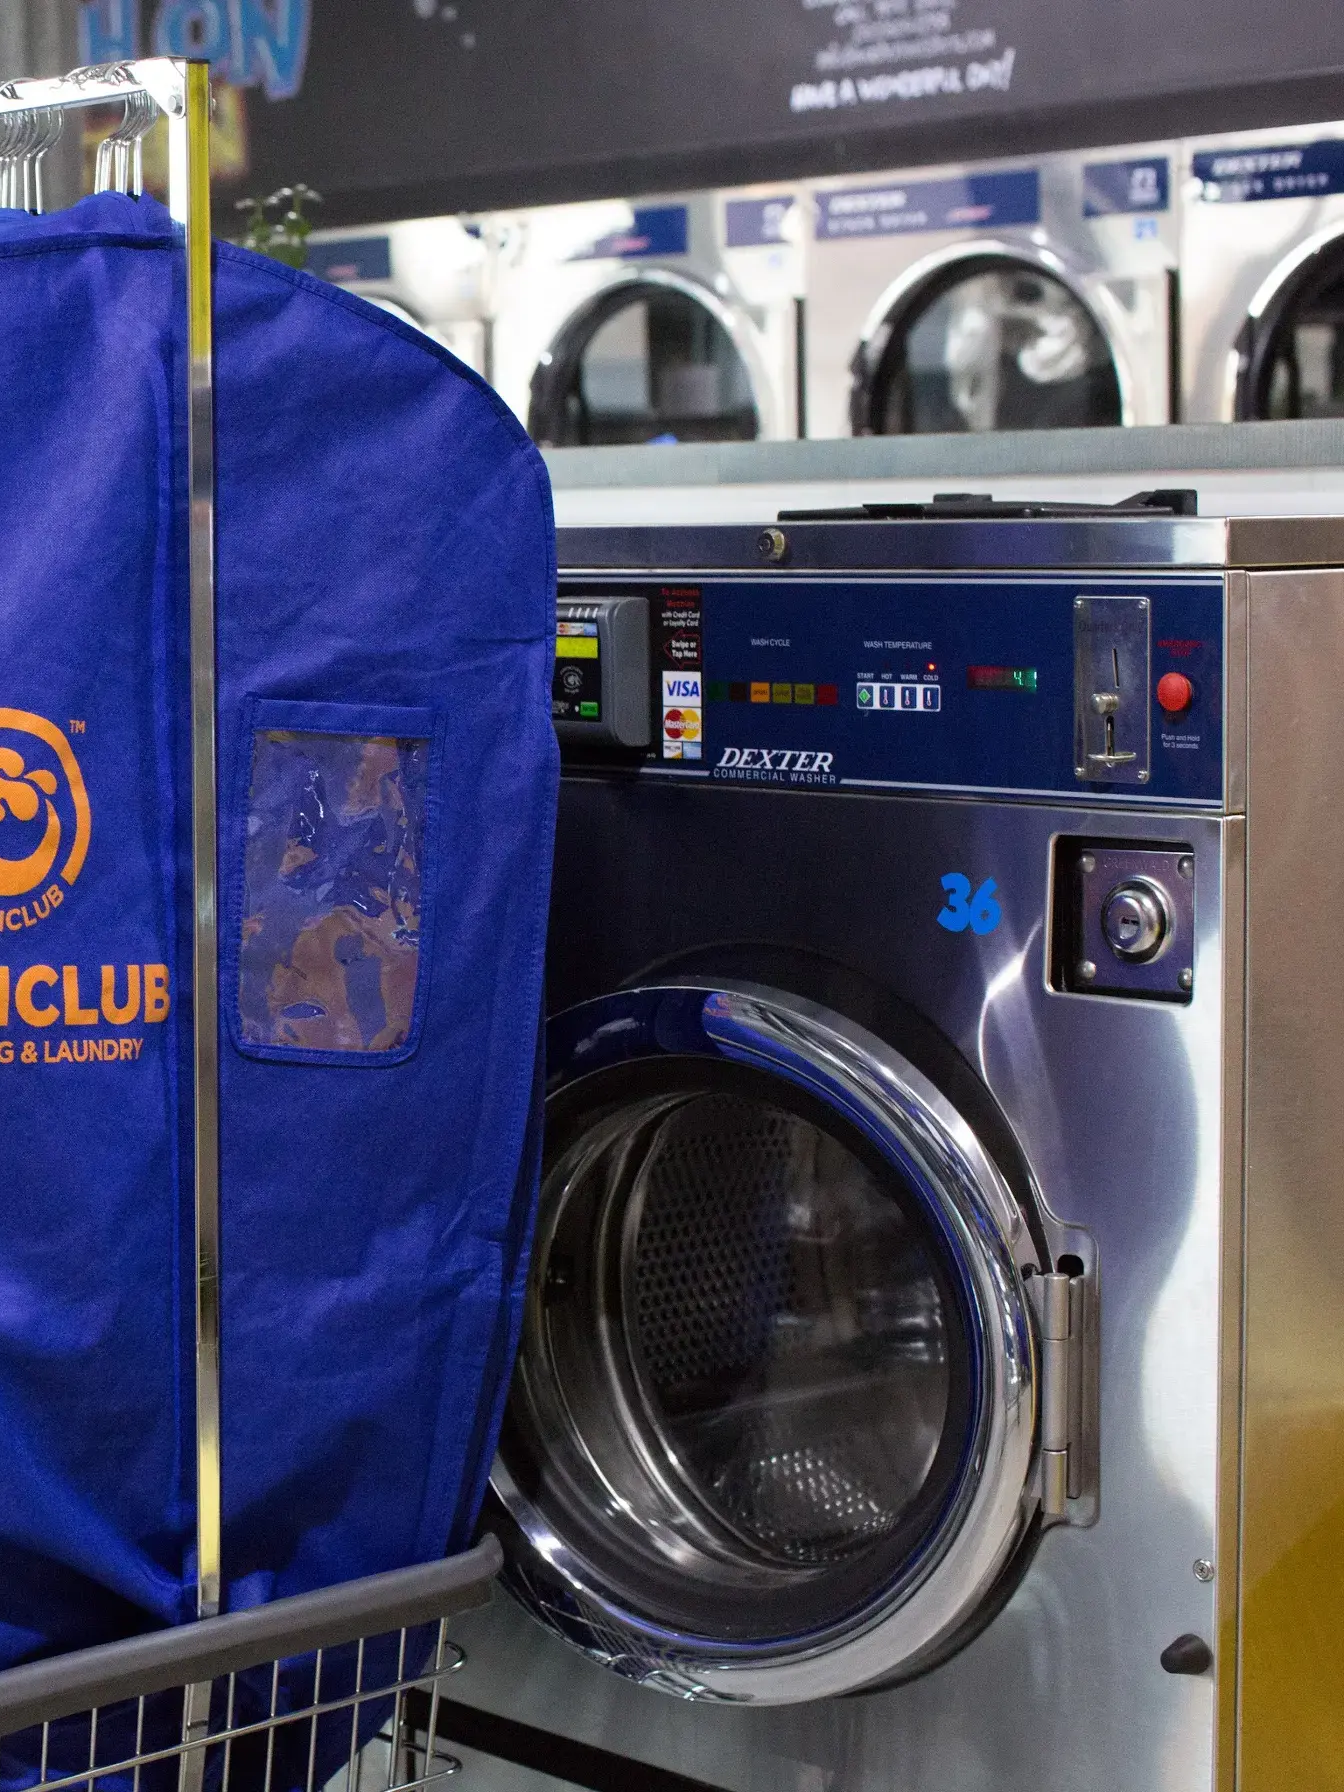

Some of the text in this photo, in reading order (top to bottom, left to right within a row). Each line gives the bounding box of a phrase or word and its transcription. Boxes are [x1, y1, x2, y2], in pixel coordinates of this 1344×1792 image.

[671, 640, 689, 649] Swipe
[770, 639, 790, 647] CYCLE
[884, 641, 932, 650] TEMPERATURE
[672, 650, 698, 659] Tap Here
[665, 680, 700, 697] VISA
[69, 720, 86, 734] TM
[716, 747, 834, 772] DEXTER
[713, 768, 837, 784] COMMERCIAL WASHER
[936, 872, 1003, 936] 36
[20, 1040, 38, 1064] &
[43, 1038, 144, 1064] LAUNDRY
